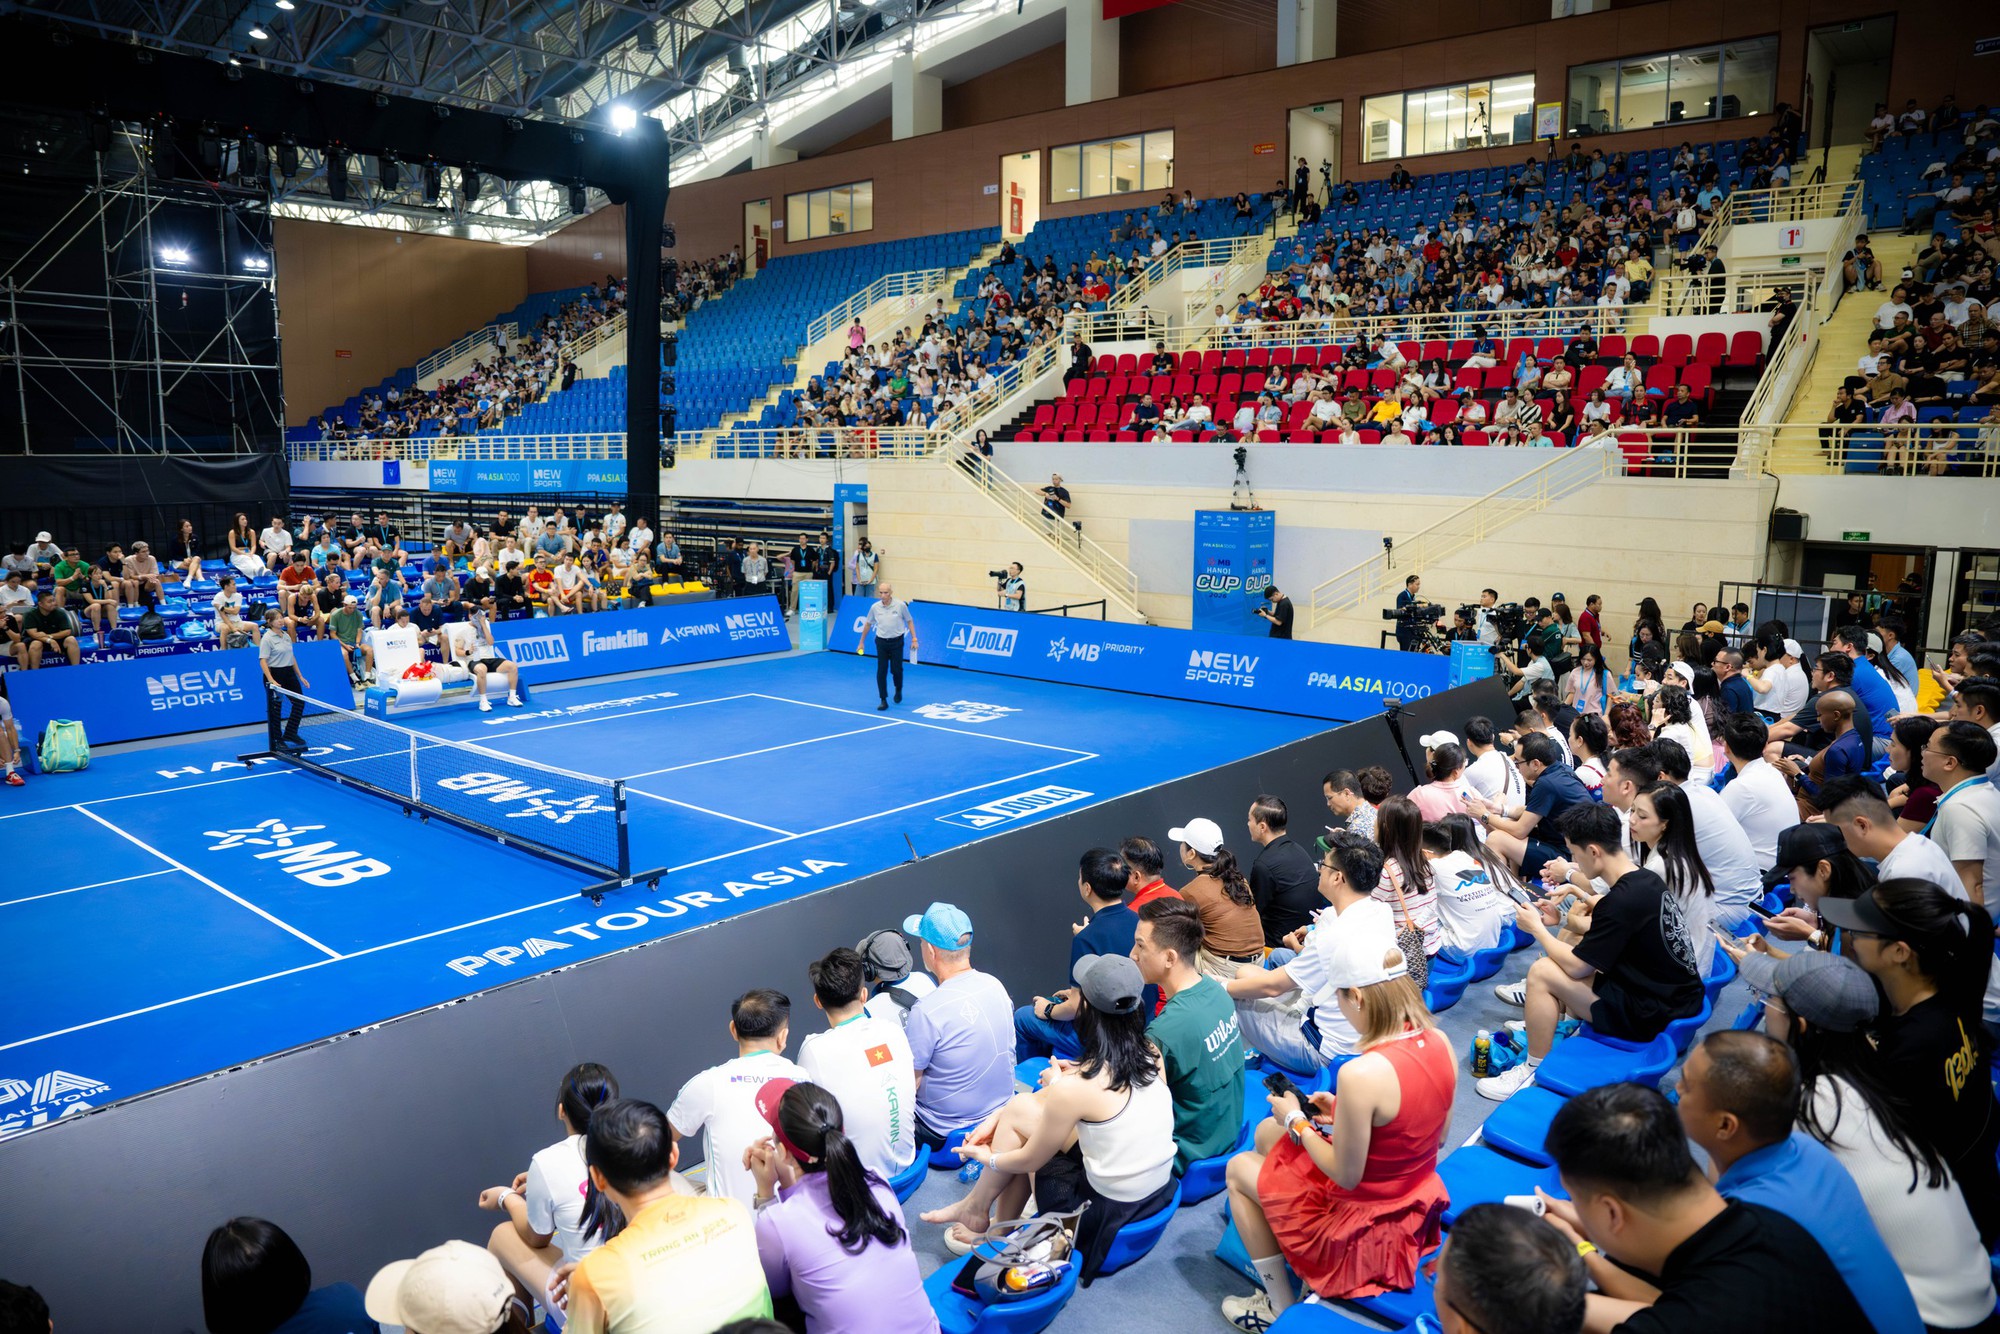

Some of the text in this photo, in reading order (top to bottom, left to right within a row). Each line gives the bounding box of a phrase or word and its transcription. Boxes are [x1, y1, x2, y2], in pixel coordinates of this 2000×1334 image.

[433, 469, 456, 478] NEW
[533, 470, 561, 479] NEW
[1196, 574, 1241, 593] CUP
[1245, 574, 1272, 594] CUP
[676, 622, 721, 638] KAIWIN
[725, 611, 774, 629] NEW
[730, 623, 780, 641] SPORTS
[969, 628, 1012, 651] JOOLA
[138, 646, 175, 655] PRIORITY
[513, 640, 566, 664] JOOLA
[1070, 642, 1145, 662] MB PRIORITY
[1189, 649, 1260, 673] NEW
[146, 667, 236, 695] NEW
[1185, 669, 1255, 688] SPORTS
[151, 688, 243, 711] SPORTS
[991, 788, 1083, 816] JOOLA
[253, 841, 391, 887] MB
[445, 858, 848, 978] PPA TOUR ASIA
[730, 1075, 764, 1084] NEW
[49, 1085, 112, 1106] TOUR
[886, 1086, 900, 1144] KAIWIN
